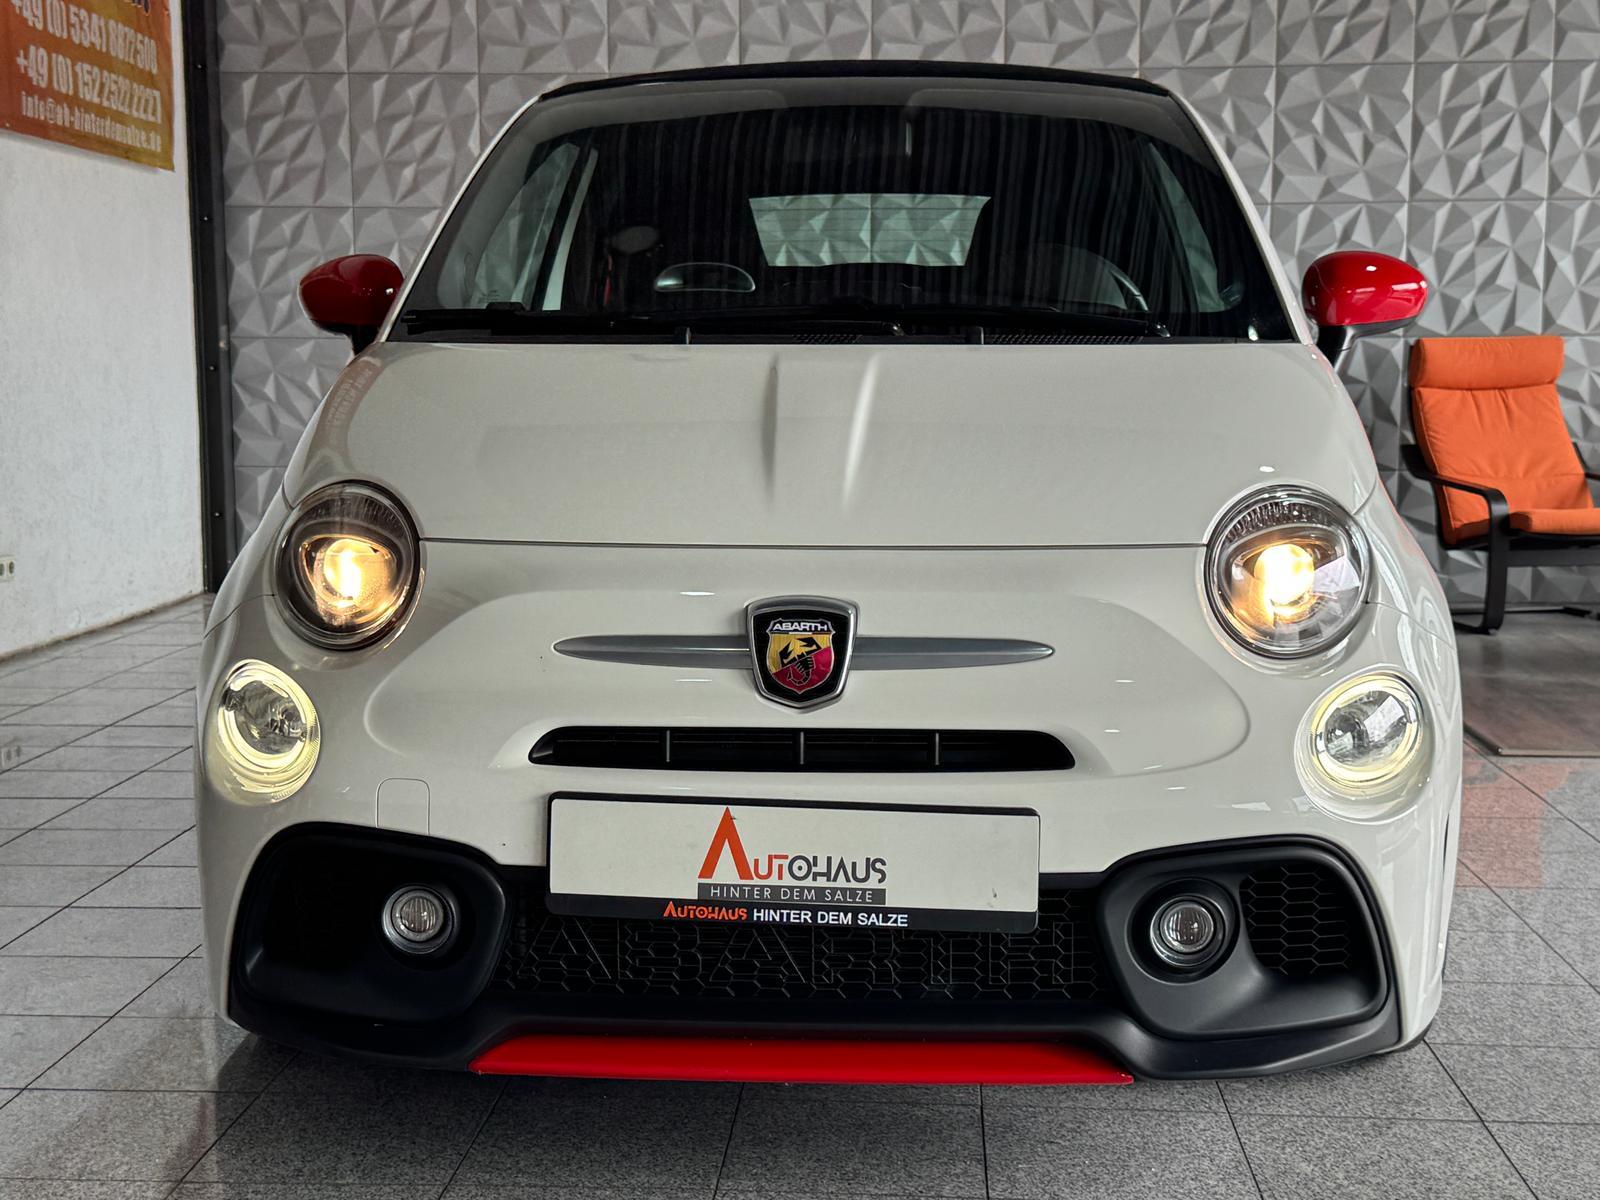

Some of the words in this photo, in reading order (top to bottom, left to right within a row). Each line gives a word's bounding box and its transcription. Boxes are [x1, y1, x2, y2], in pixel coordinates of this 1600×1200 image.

[16, 45, 48, 88] +49
[52, 53, 73, 96] (0)
[772, 622, 827, 631] ABARTH
[698, 806, 887, 884] AUTOHAUS
[710, 886, 771, 900] HINTER
[780, 888, 816, 901] DEM
[825, 889, 873, 903] SALZE
[663, 900, 748, 920] AUTOHAUS
[753, 908, 812, 924] HINTER
[817, 911, 852, 925] DEM
[857, 912, 908, 927] SALZE
